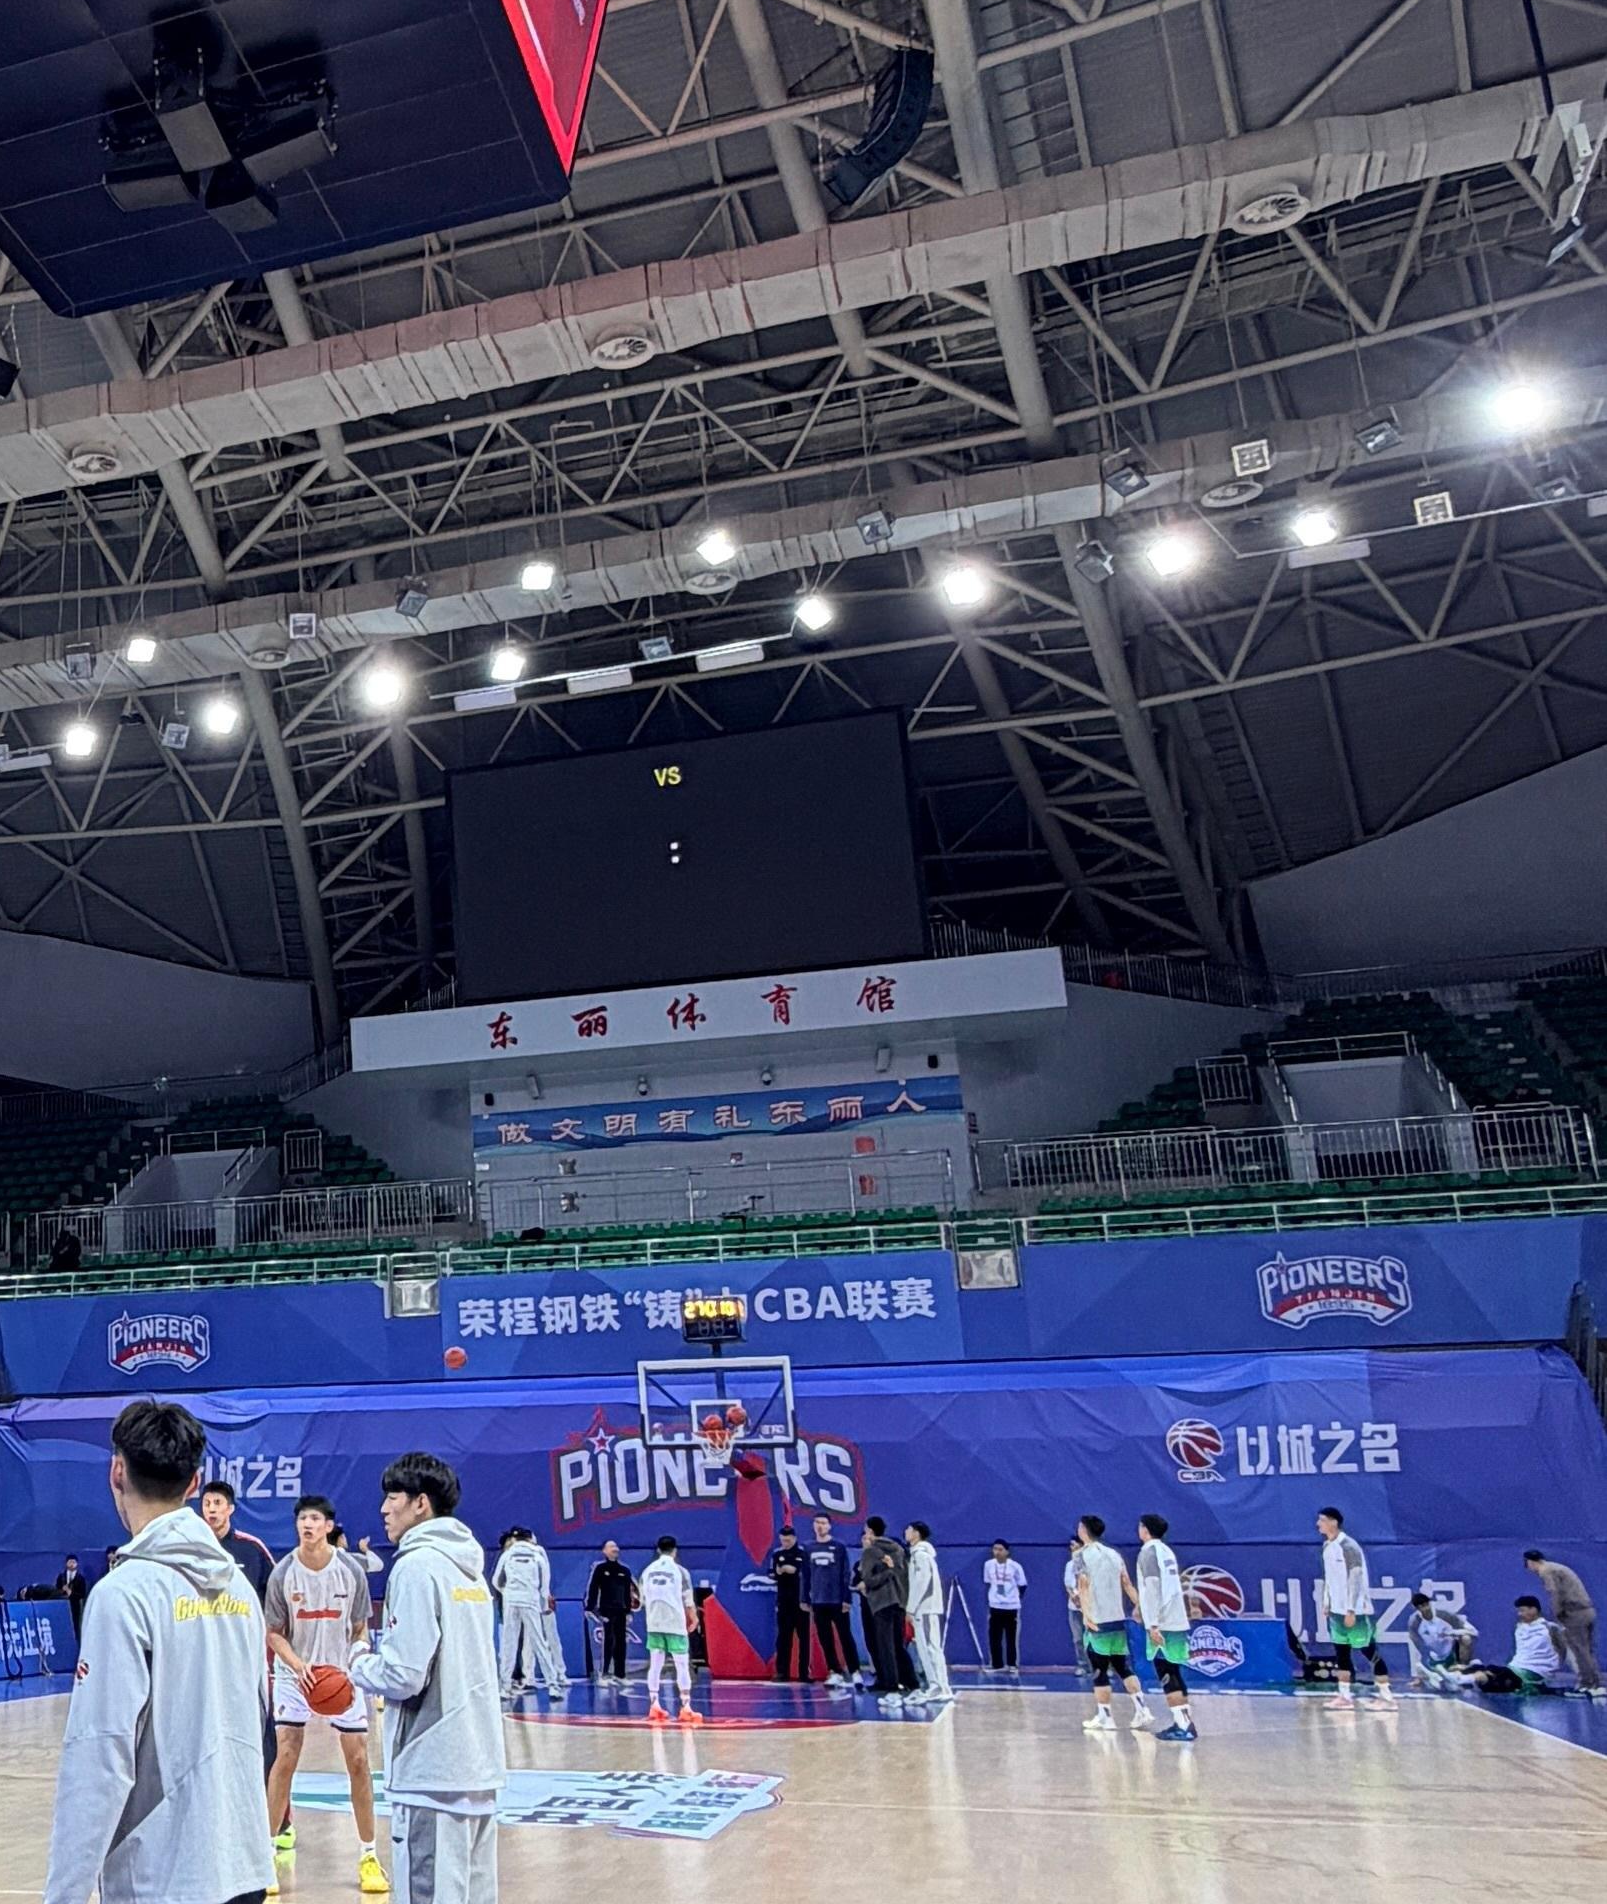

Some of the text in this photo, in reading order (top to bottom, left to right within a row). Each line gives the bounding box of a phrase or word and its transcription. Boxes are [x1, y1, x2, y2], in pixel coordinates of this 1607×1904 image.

[653, 765, 682, 788] VS
[486, 974, 900, 1051] 东丽体育馆
[497, 1089, 929, 1146] 做文明有礼东丽人
[1235, 1421, 1402, 1477] 以城之名
